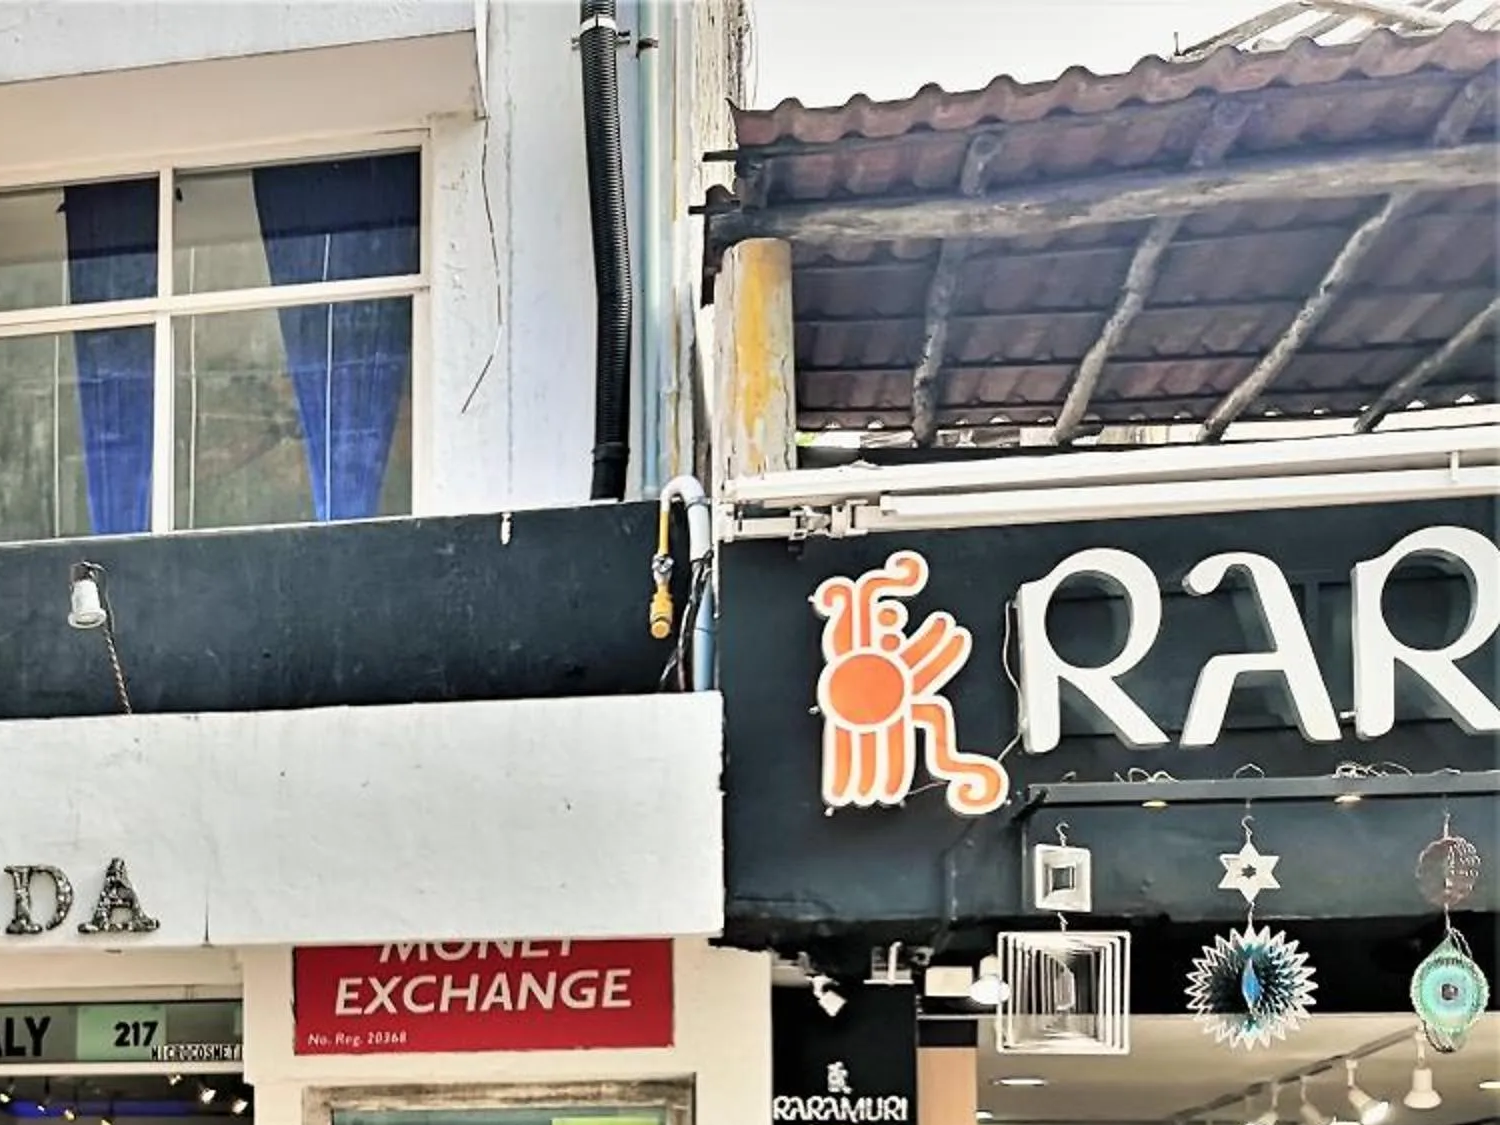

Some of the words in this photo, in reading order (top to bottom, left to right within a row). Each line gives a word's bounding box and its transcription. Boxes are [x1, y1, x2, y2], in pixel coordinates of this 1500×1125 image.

[335, 968, 632, 1016] EXCHANGE
[114, 1021, 159, 1047] 217
[773, 1095, 909, 1123] RARAMURI
